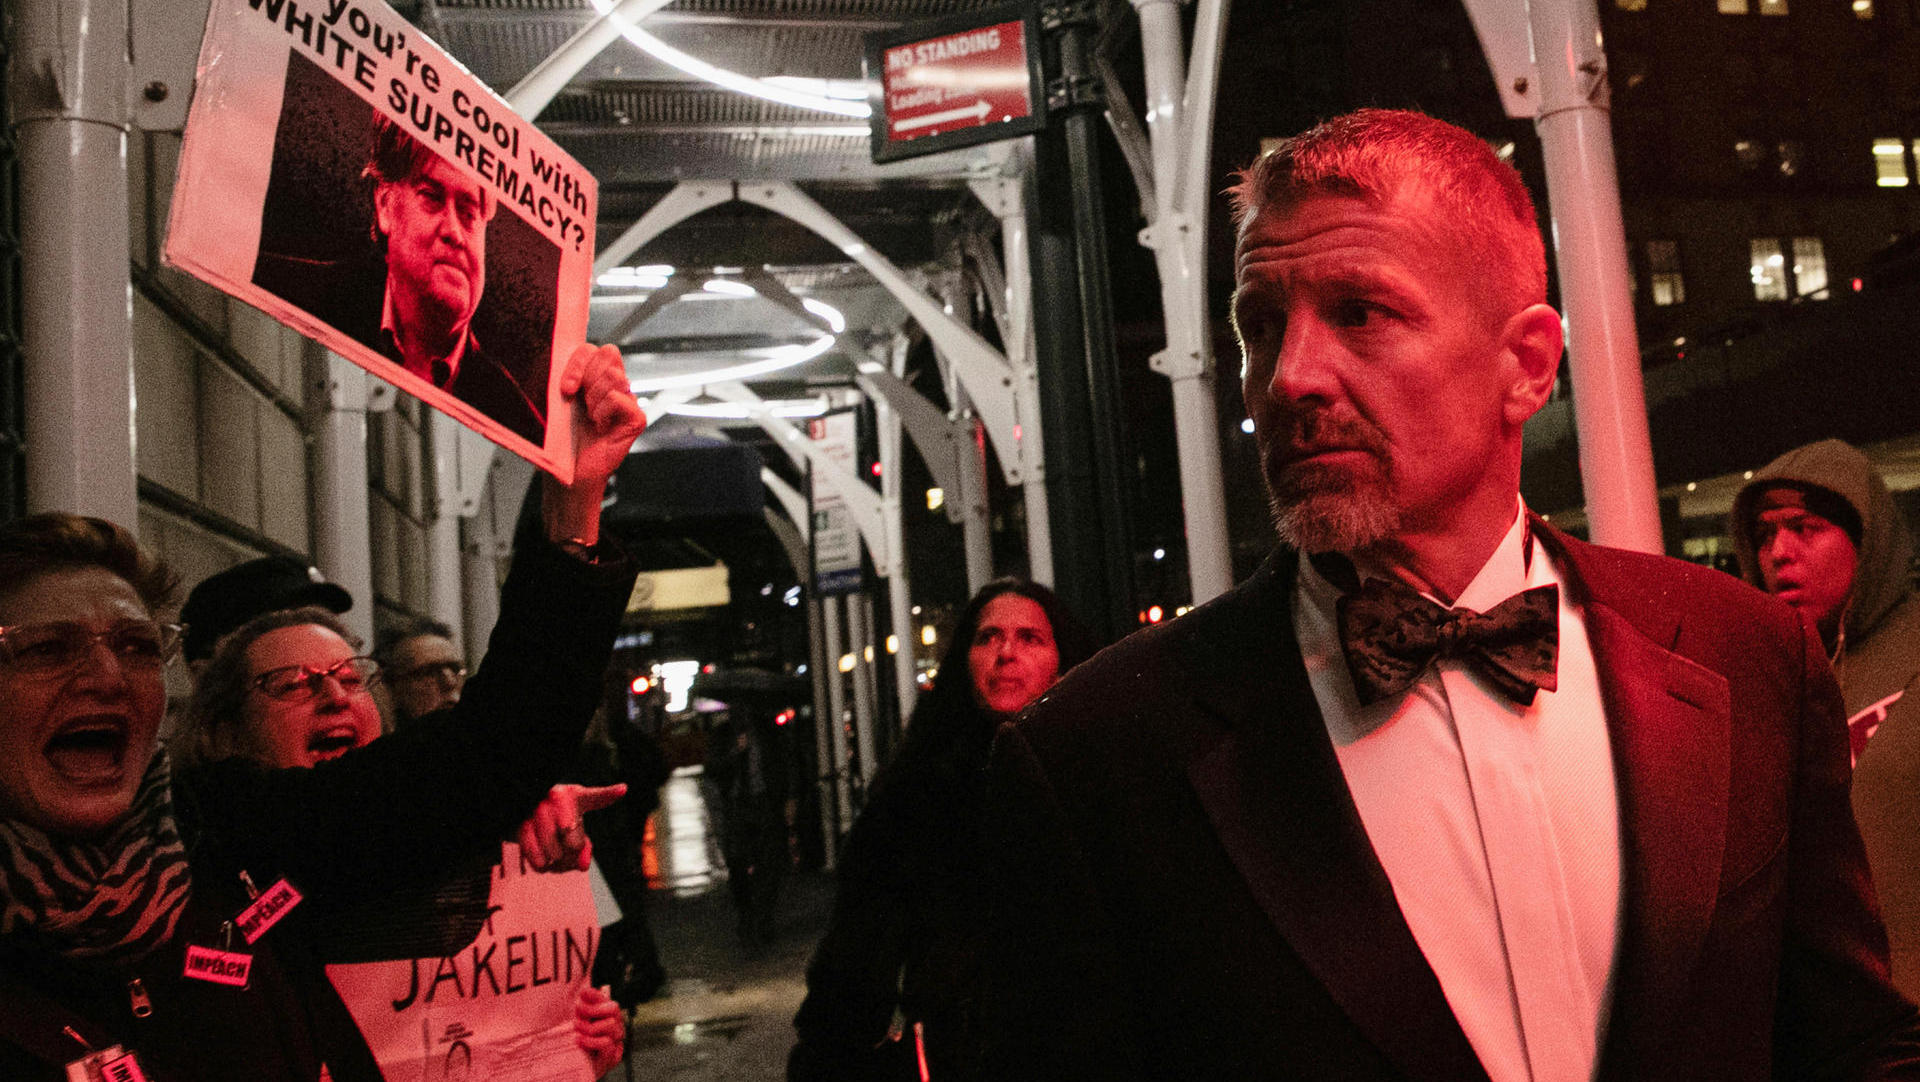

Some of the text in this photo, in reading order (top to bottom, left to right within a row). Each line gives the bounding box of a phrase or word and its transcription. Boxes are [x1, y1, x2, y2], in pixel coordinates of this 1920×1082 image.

[888, 28, 1001, 71] NO STANDING
[249, 0, 585, 252] WHITE SUPREMACY?
[322, 0, 587, 217] you're cool with
[189, 954, 247, 979] IMPEACH
[392, 926, 593, 1012] JAKELIN
